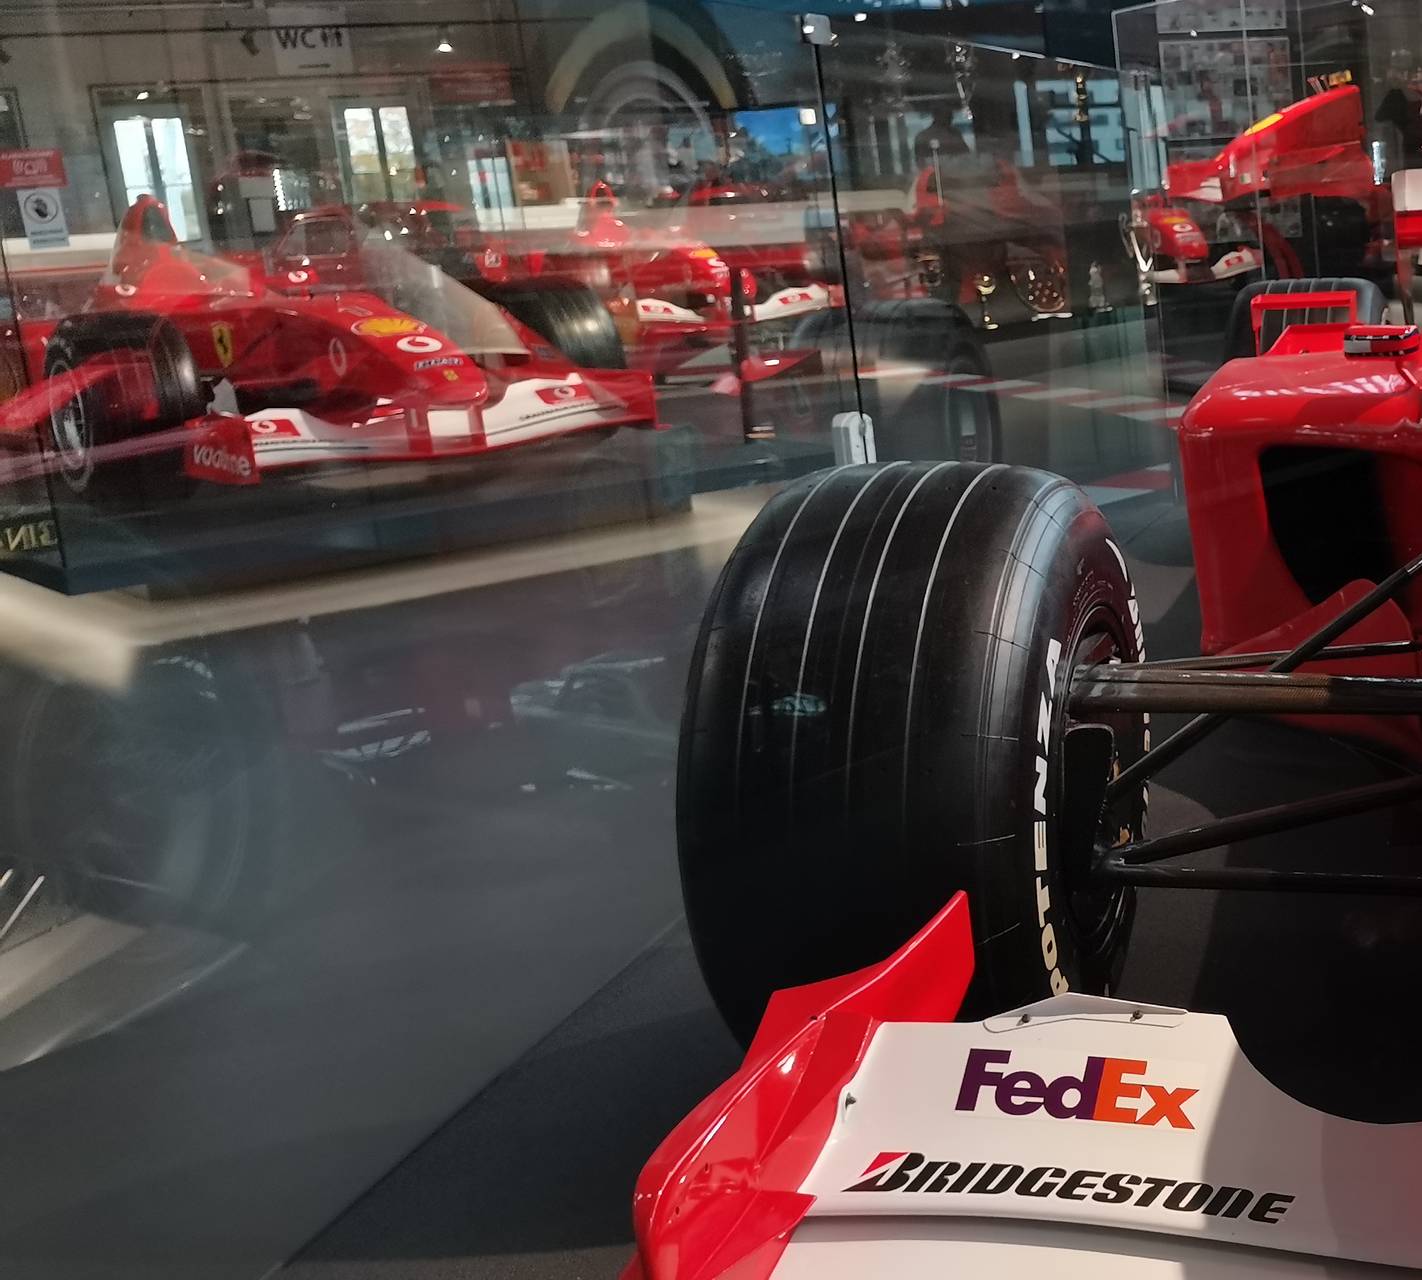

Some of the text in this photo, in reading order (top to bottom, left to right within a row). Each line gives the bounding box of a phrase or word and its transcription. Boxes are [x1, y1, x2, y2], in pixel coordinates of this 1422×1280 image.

[1033, 637, 1070, 997] POTENZA
[954, 1047, 1200, 1130] FedEx
[842, 1151, 1296, 1224] BRIDGESTONE
